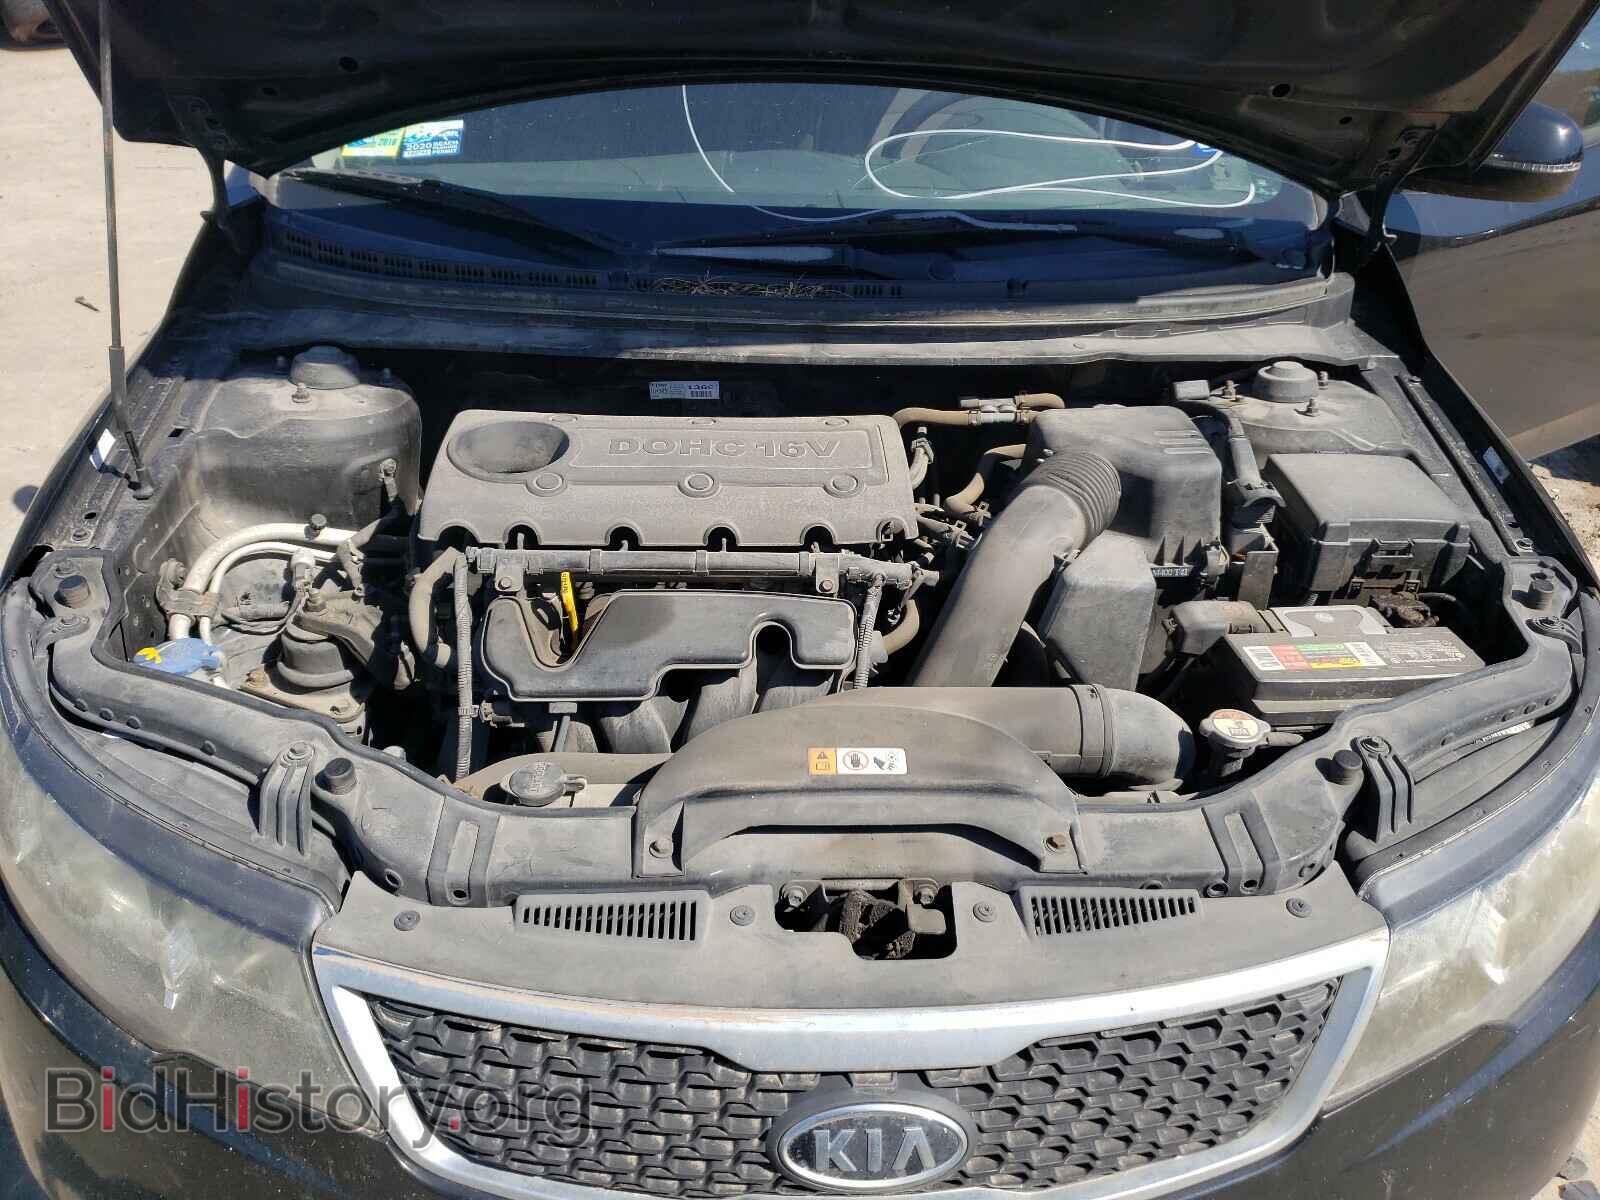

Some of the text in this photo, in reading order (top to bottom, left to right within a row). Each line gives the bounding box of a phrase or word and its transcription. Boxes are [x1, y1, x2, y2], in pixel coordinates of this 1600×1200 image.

[405, 143, 432, 151] 2020
[608, 439, 841, 457] DOHC 16V
[812, 1127, 937, 1172] KIA
